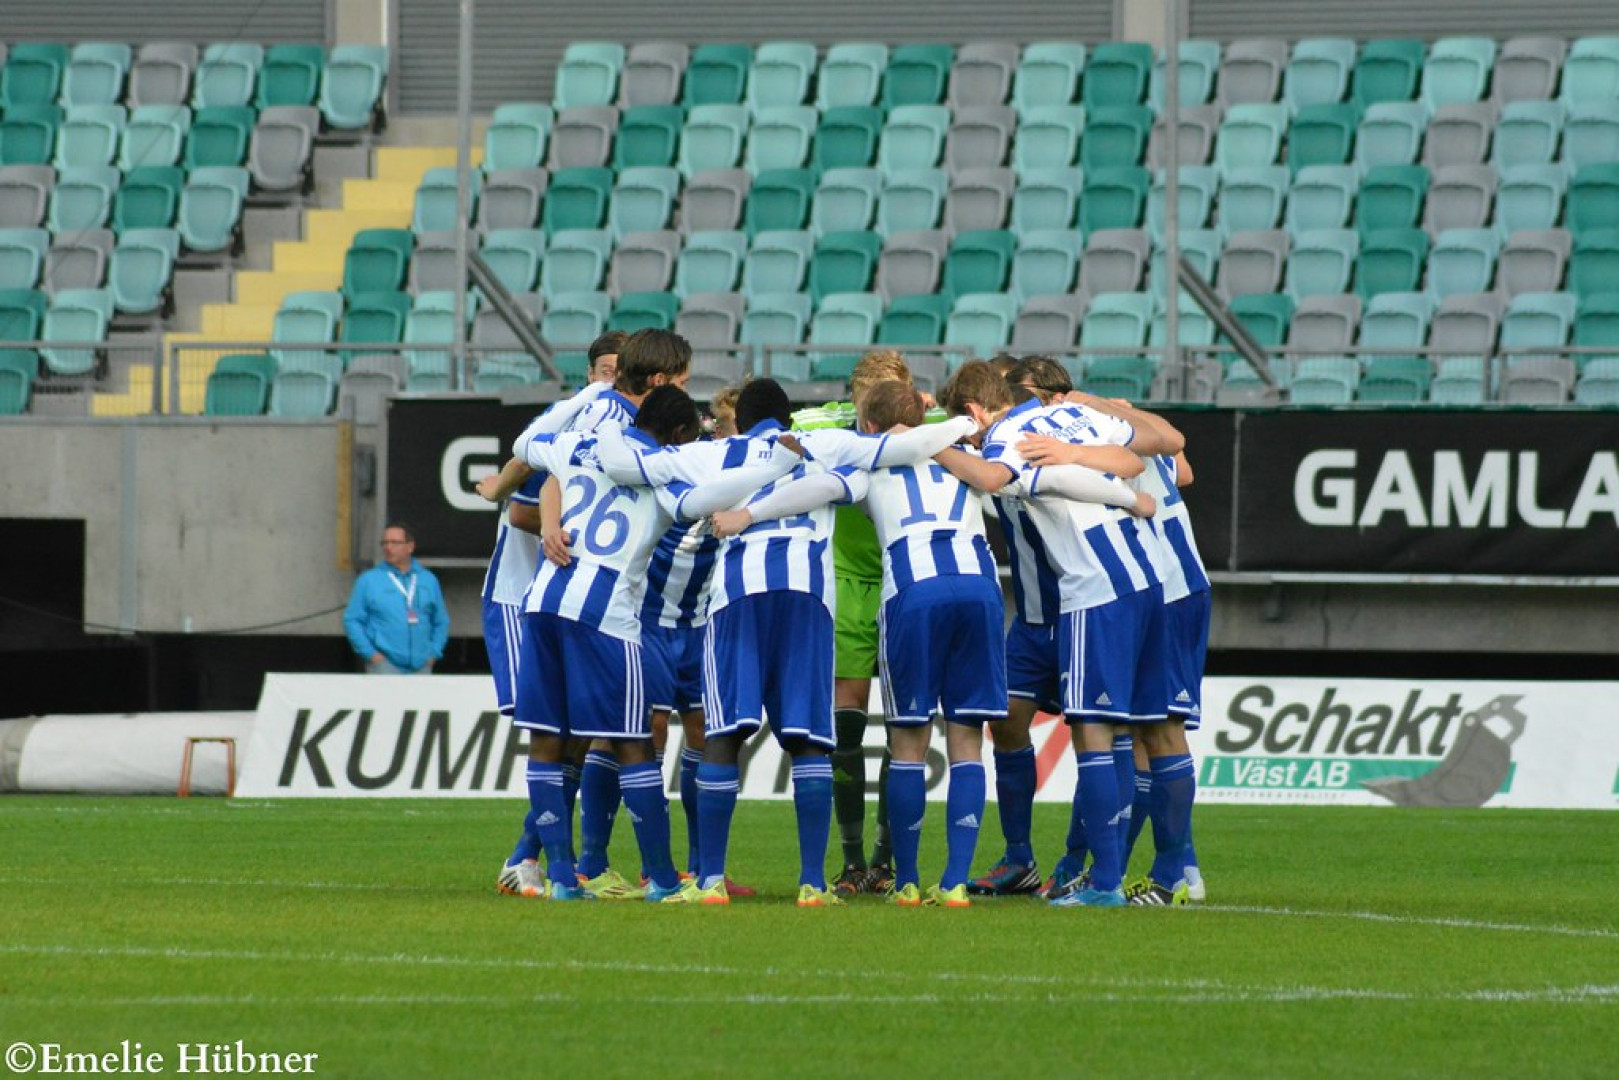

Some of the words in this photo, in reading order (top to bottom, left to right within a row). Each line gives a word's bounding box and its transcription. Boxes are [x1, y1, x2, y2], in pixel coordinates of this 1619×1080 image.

[560, 474, 639, 556] 26
[889, 465, 969, 527] 17
[1294, 448, 1619, 528] GAMLA
[1215, 685, 1463, 756] Schakt
[1208, 759, 1221, 785] i
[1233, 759, 1298, 786] Väst
[1301, 761, 1351, 787] AB
